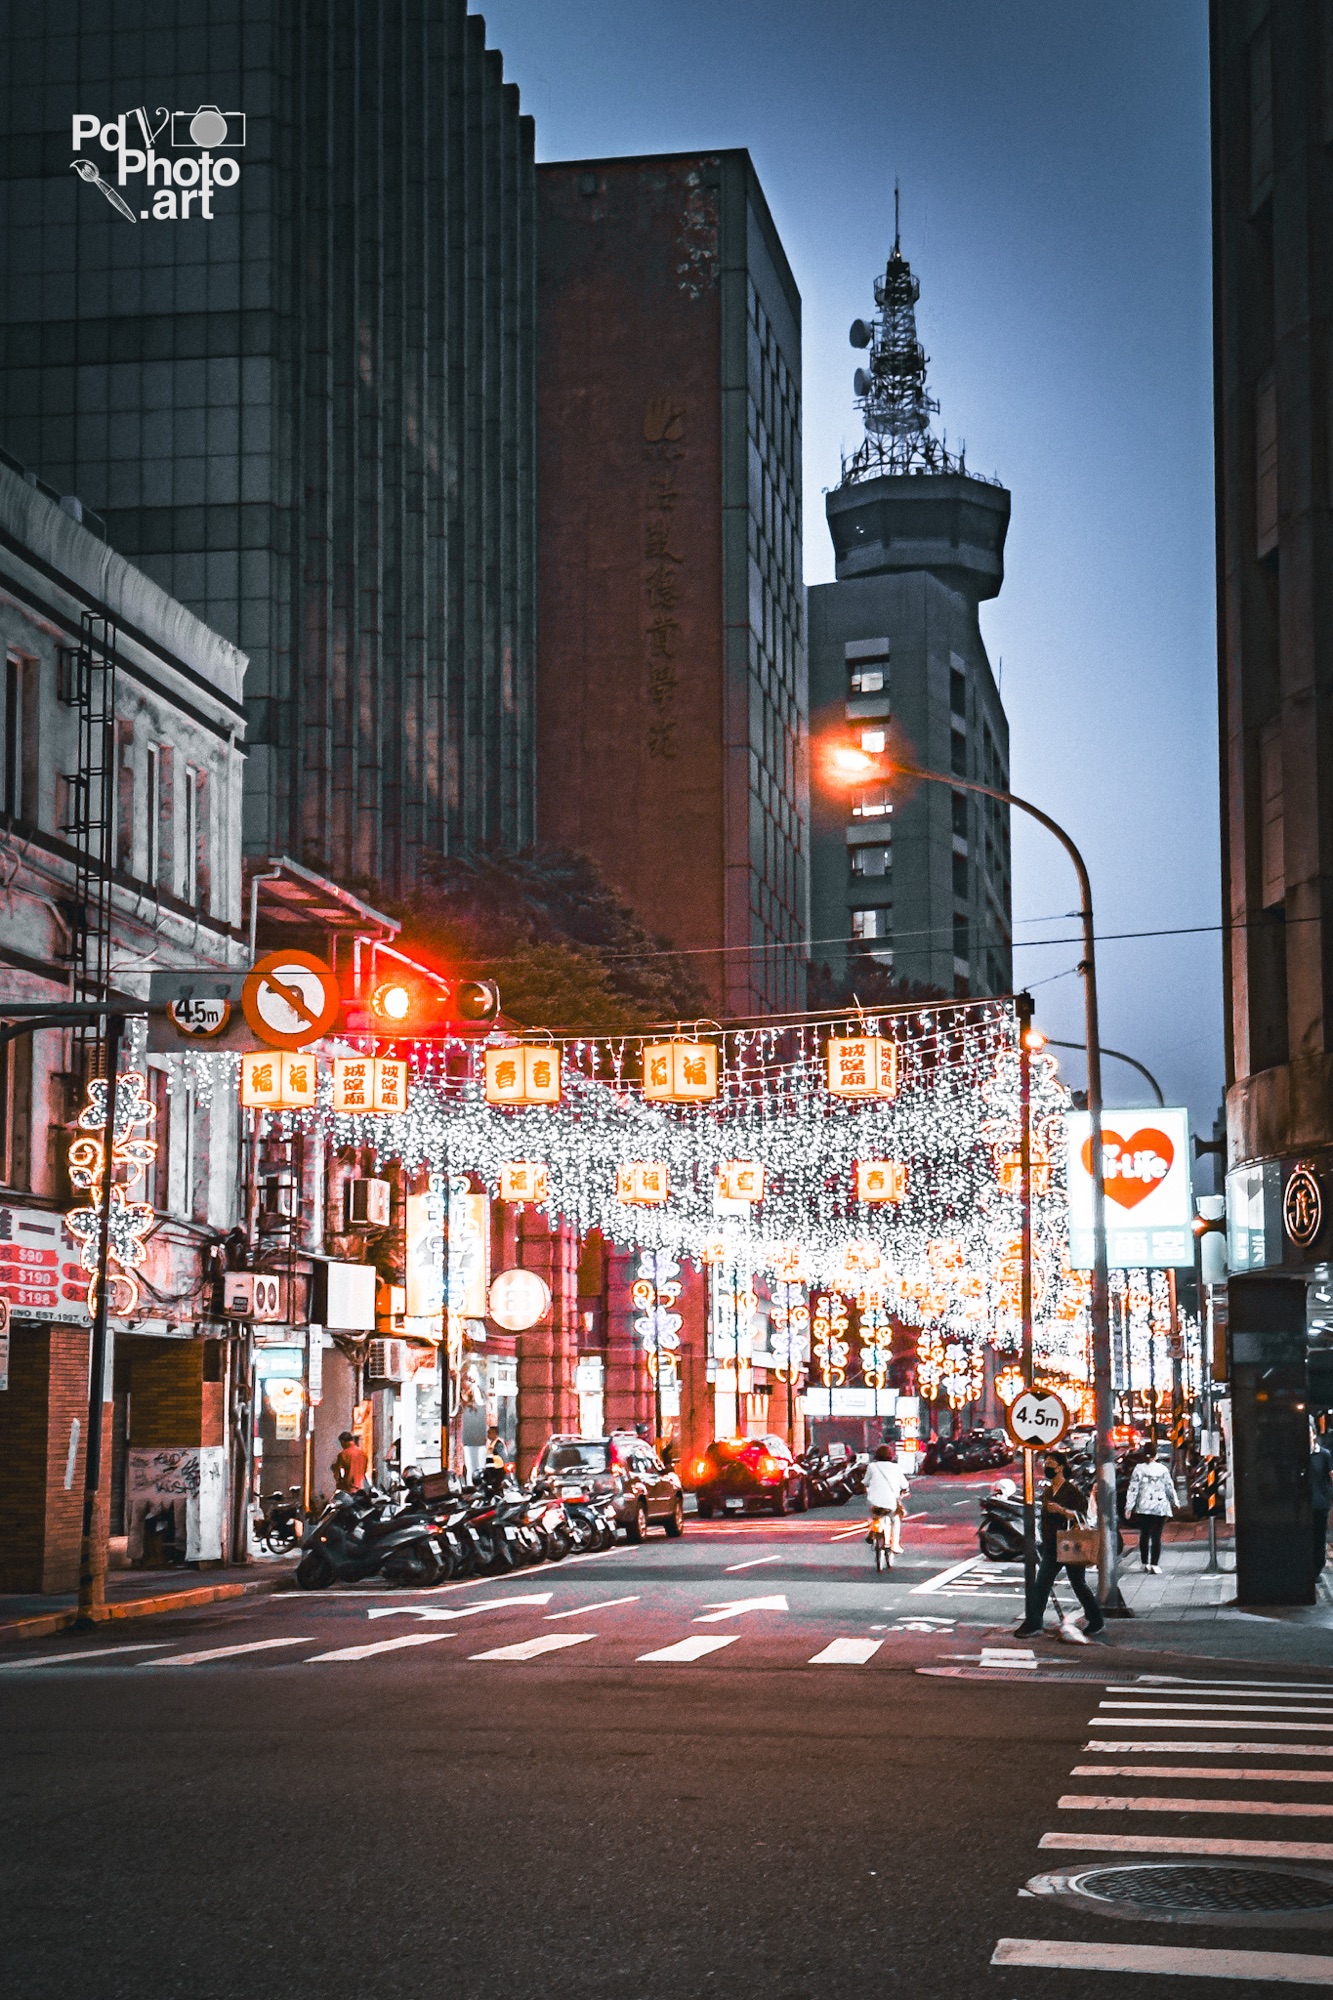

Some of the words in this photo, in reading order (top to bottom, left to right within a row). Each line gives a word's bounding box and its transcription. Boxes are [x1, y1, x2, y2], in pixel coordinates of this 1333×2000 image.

[251, 1063, 273, 1092] 福
[289, 1063, 308, 1092] 福
[495, 1060, 516, 1089] 春
[533, 1059, 551, 1088] 春
[650, 1056, 667, 1086] 福
[684, 1055, 707, 1085] 福
[839, 1043, 866, 1086] 城隍廟
[343, 1063, 366, 1105] 城隍廟
[381, 1063, 399, 1105] 城隍廟
[510, 1170, 527, 1191] 福
[642, 1170, 660, 1191] 福
[867, 1170, 884, 1190] 春
[18, 1248, 44, 1263] $90
[1016, 1406, 1059, 1427] 4.5m
